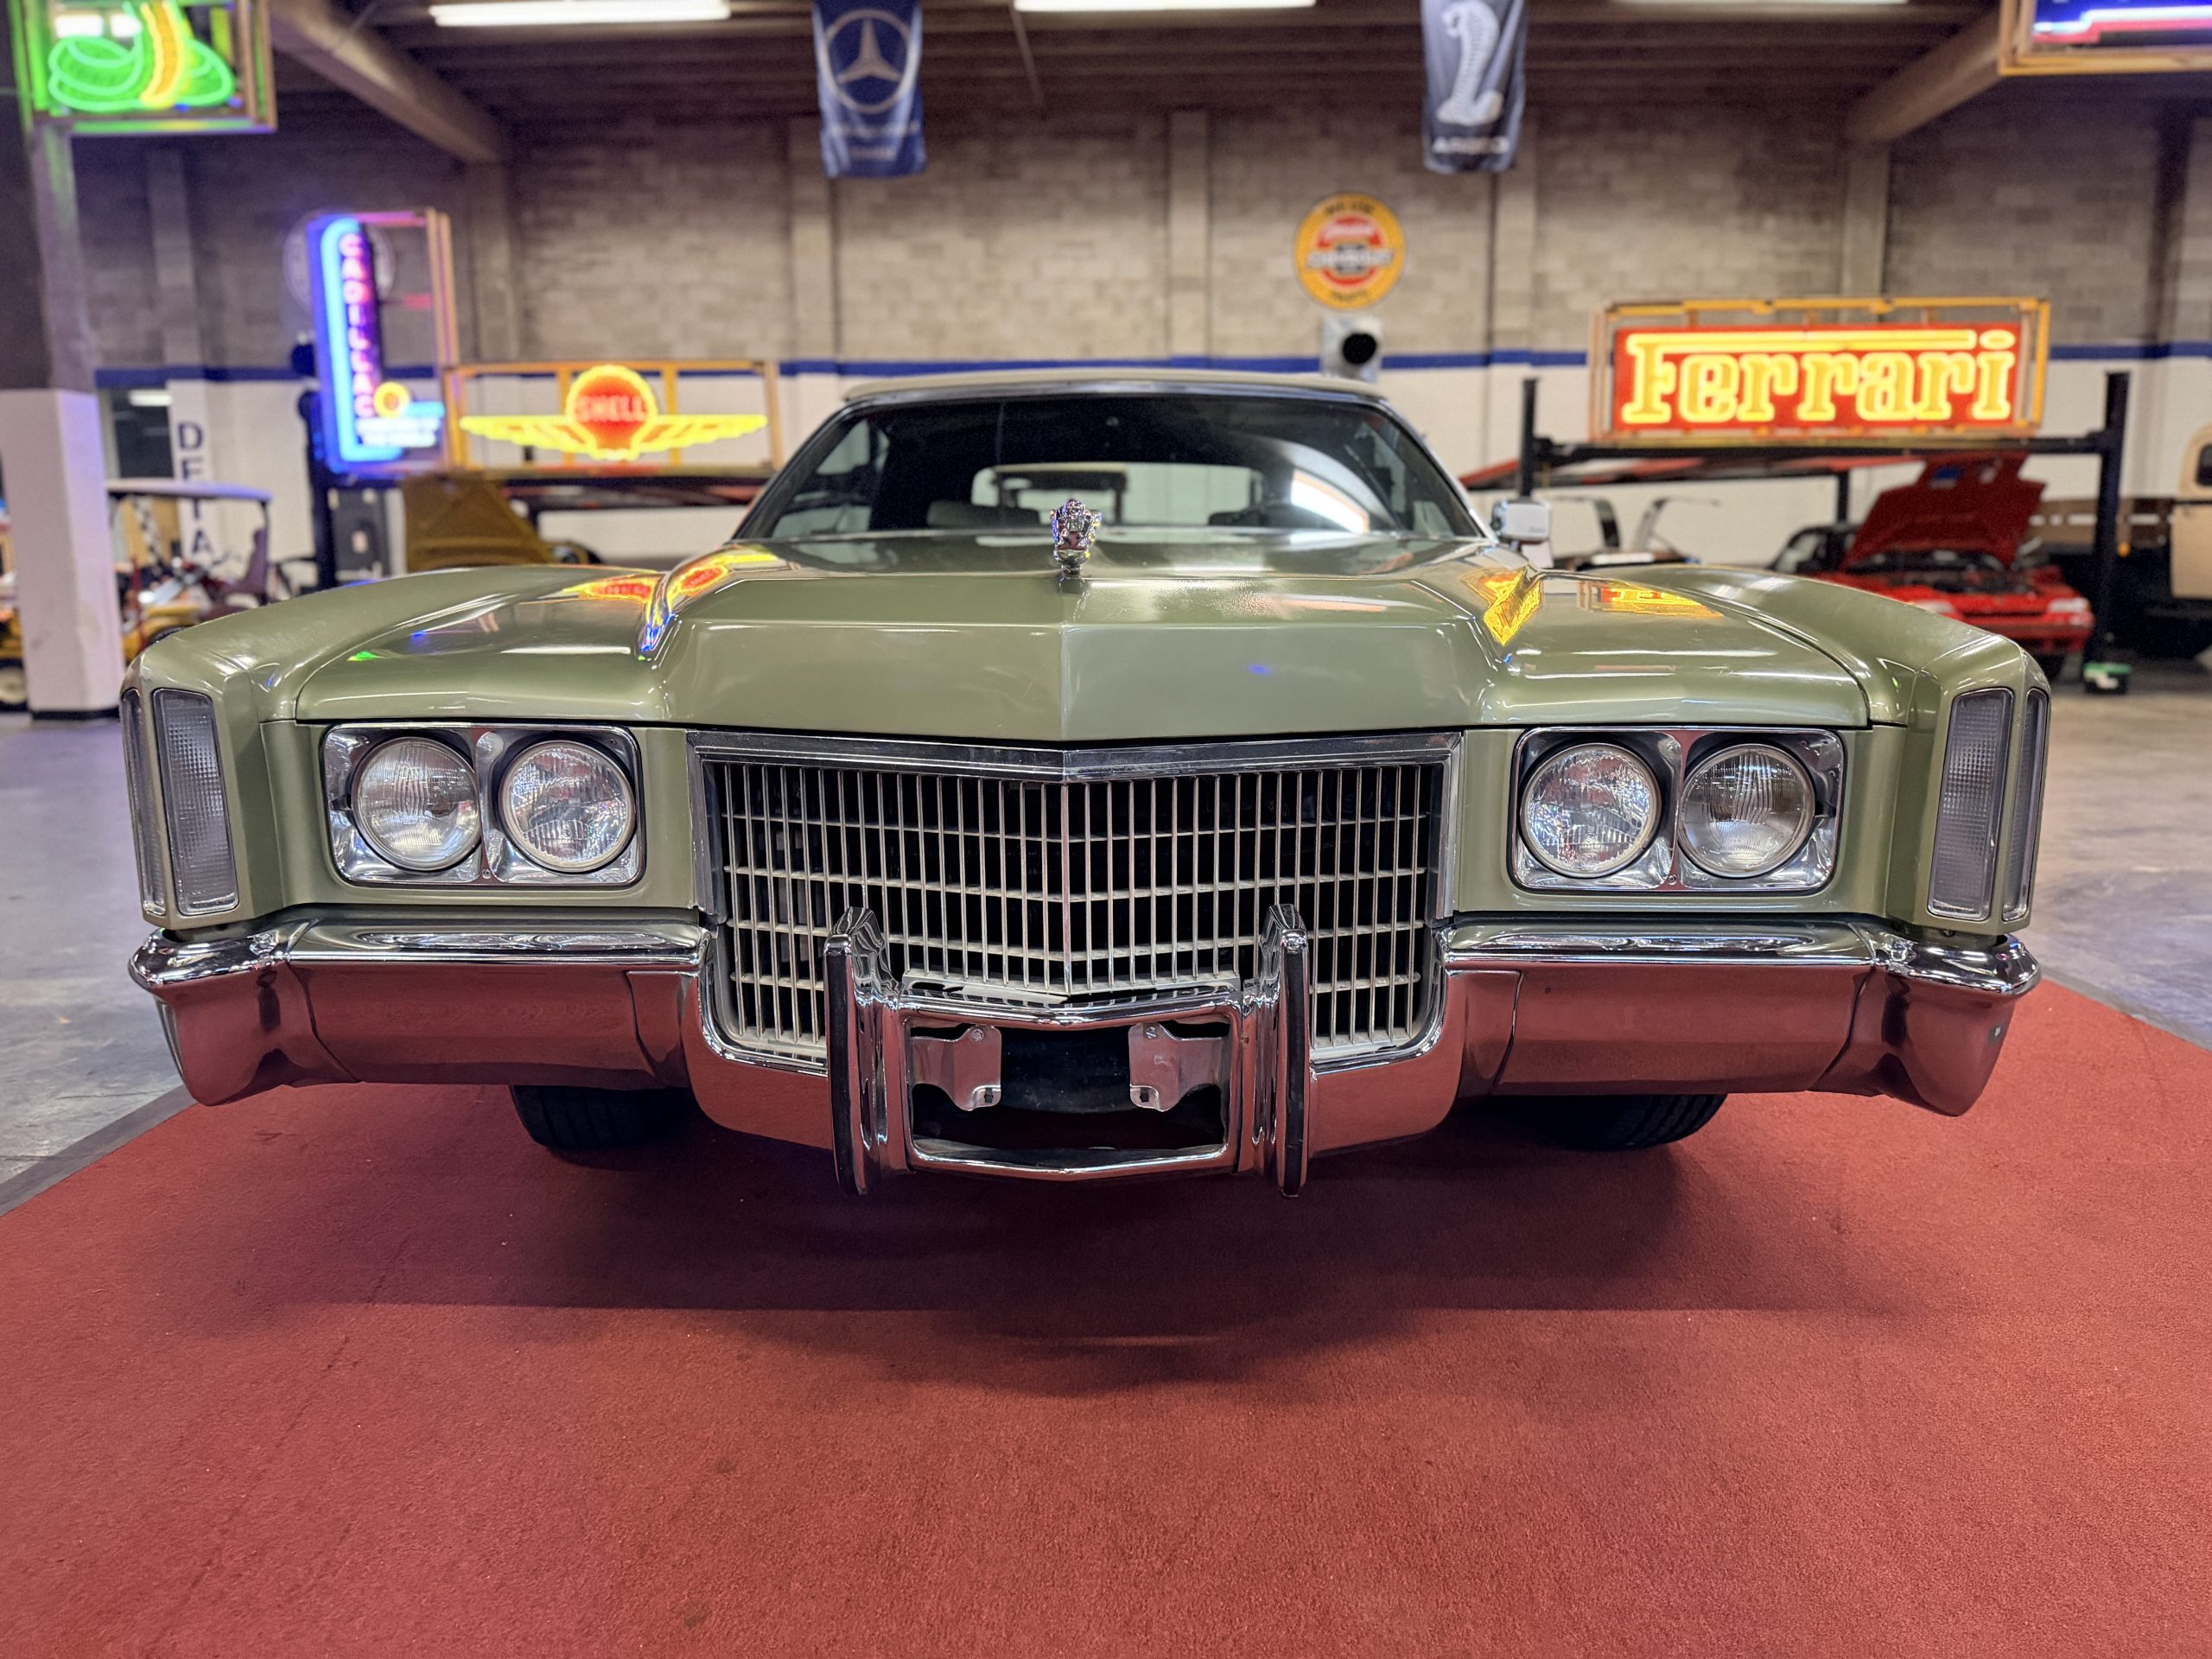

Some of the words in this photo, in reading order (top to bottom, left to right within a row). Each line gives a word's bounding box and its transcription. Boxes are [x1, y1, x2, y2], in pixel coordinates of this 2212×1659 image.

[340, 232, 378, 418] CADILLAC
[575, 395, 649, 423] SHELL
[1621, 329, 2016, 424] Ferrari
